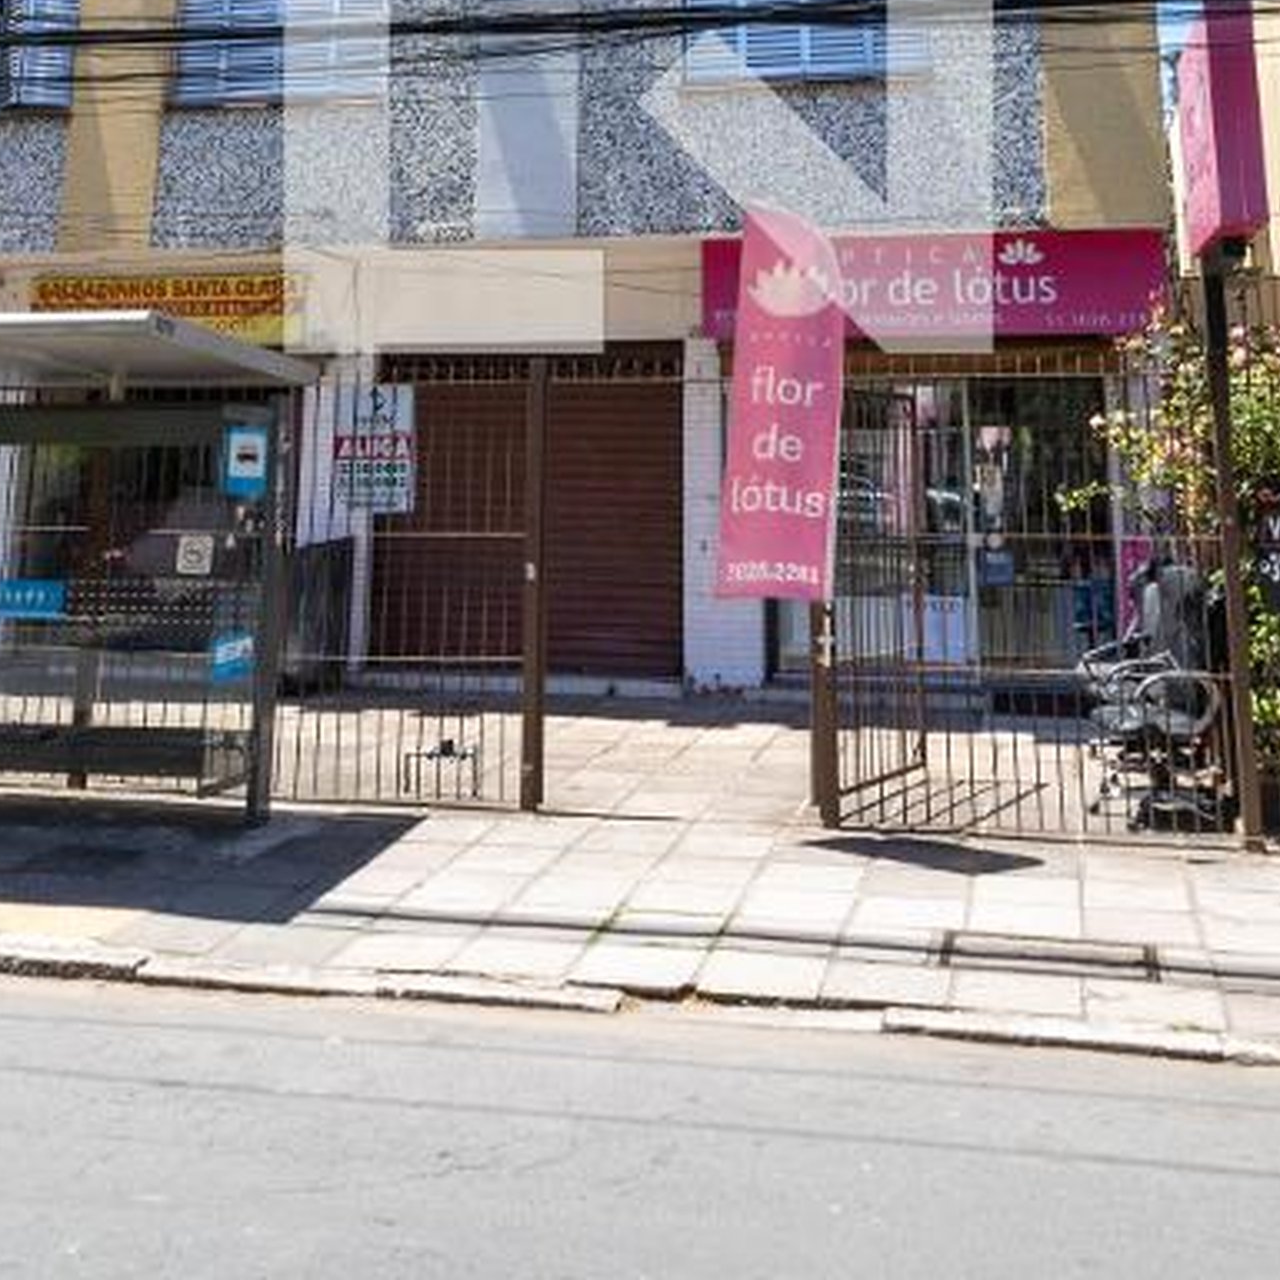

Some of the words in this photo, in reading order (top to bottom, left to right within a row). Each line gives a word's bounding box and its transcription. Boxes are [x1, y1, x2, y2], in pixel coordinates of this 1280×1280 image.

[171, 278, 231, 297] SANTA
[888, 271, 938, 305] de
[954, 266, 1058, 304] lótus
[751, 366, 824, 407] flor
[337, 436, 410, 457] ALUGA
[752, 422, 803, 462] de
[731, 476, 826, 518] lótus
